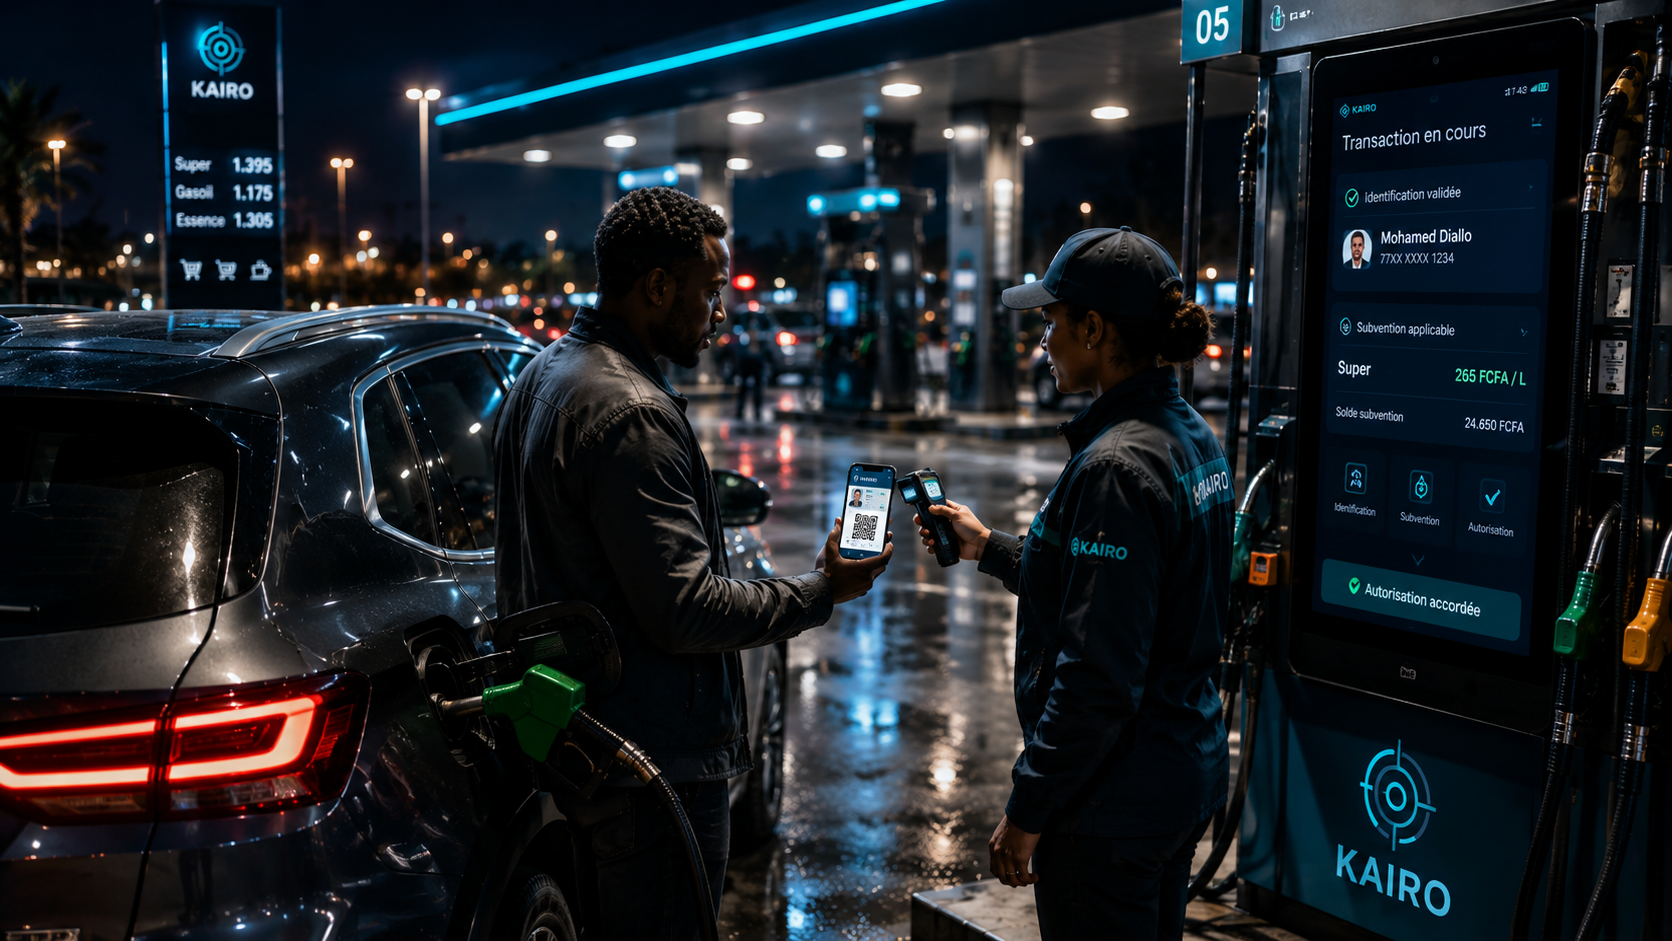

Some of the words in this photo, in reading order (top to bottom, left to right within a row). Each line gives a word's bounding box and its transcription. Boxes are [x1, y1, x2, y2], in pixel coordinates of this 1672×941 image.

[1196, 6, 1229, 44] 05
[192, 81, 253, 99] KAIRO
[1352, 104, 1376, 113] KAIRO
[1343, 129, 1419, 150] Transaction
[1424, 130, 1440, 142] en
[1446, 125, 1486, 140] cours
[175, 156, 211, 173] Super
[233, 157, 273, 174] 1.395
[175, 184, 213, 199] Gasoil
[233, 184, 273, 201] 1.175
[1365, 189, 1424, 203] Identification
[1427, 186, 1461, 199] validée
[176, 213, 225, 227] Essence
[234, 212, 273, 228] 1.305
[1381, 229, 1436, 244] Mohamed
[1440, 229, 1471, 242] Diallo
[1381, 253, 1402, 263] 77XX
[1405, 253, 1428, 263] XXXX
[1432, 252, 1454, 263] 1234
[1357, 322, 1406, 333] Subvention
[1408, 324, 1455, 336] applicable
[1338, 360, 1371, 378] Super
[1456, 368, 1476, 382] 265
[1480, 370, 1508, 384] FCFA
[1336, 406, 1358, 418] Solde
[1360, 409, 1403, 422] subvention
[1465, 417, 1496, 430] 24.650
[1500, 420, 1524, 433] FCFA
[1400, 512, 1439, 526] Subvention
[1468, 522, 1513, 537] Autorisation
[1080, 541, 1127, 559] KAIRO
[1365, 584, 1426, 606] Autorisation
[1430, 598, 1480, 616] accordée
[1336, 843, 1450, 916] KAIRO
